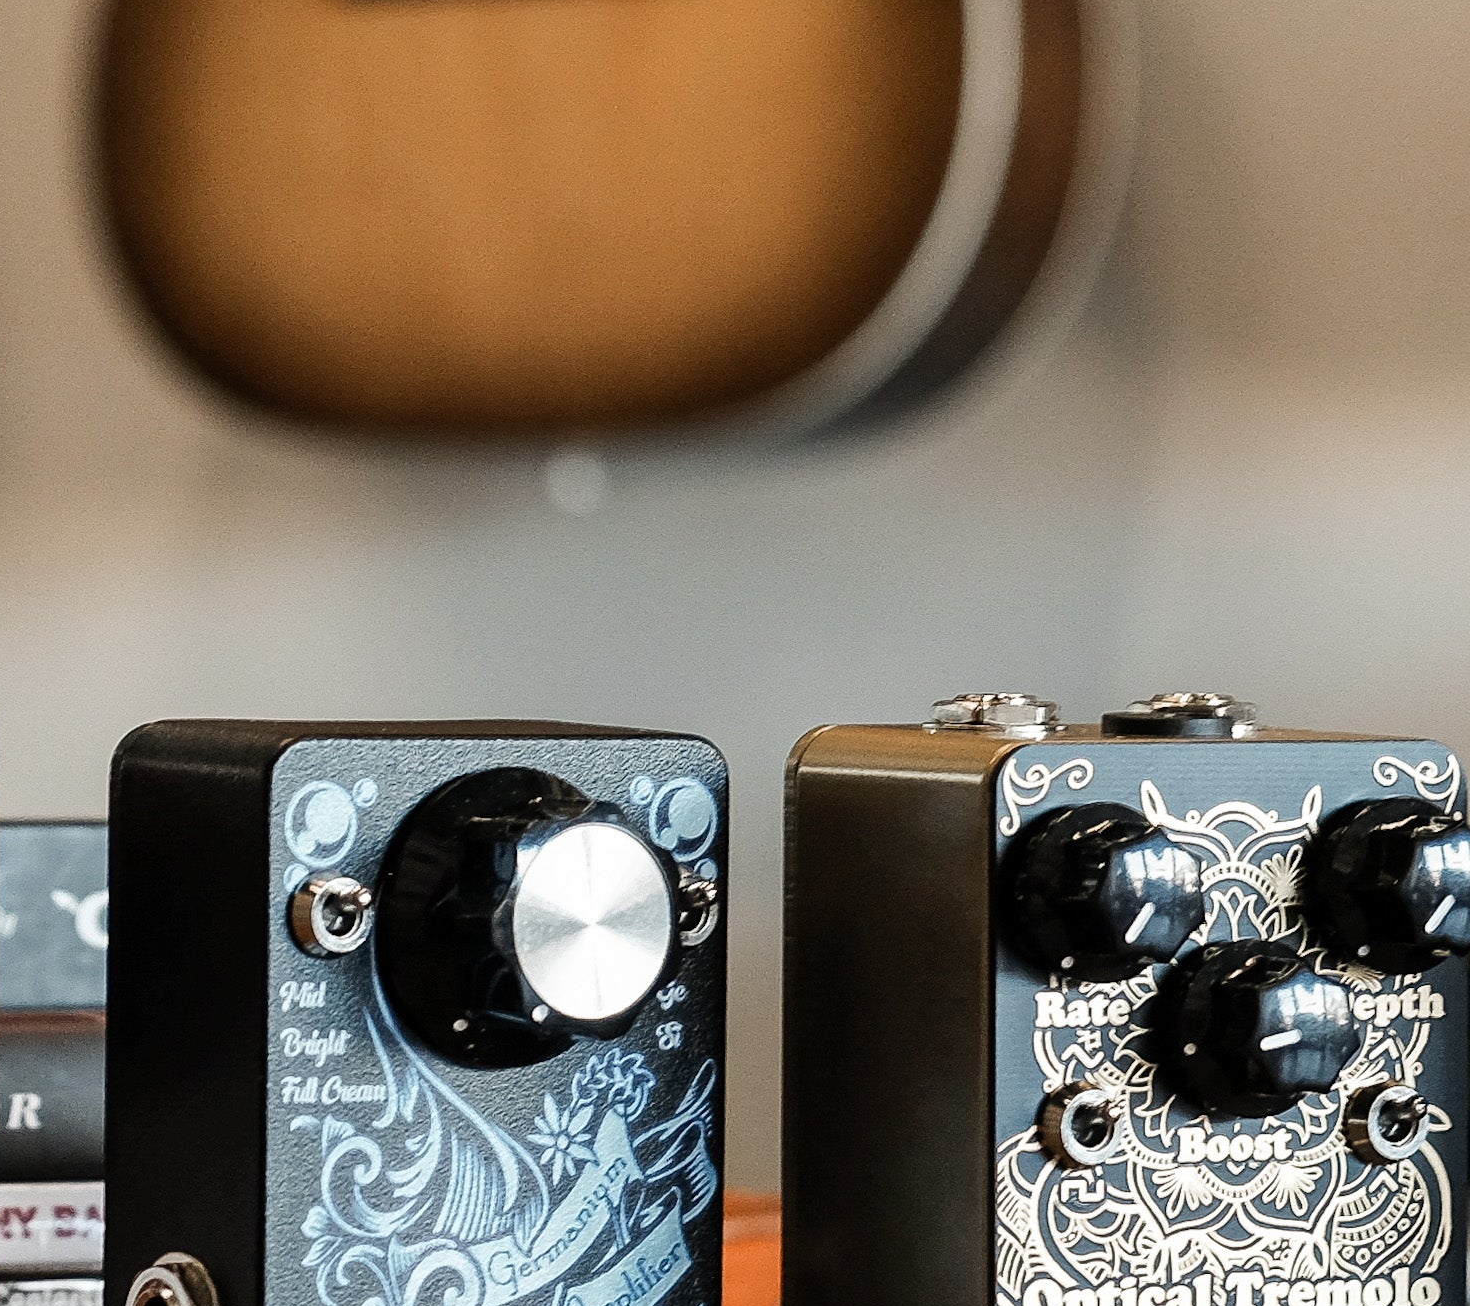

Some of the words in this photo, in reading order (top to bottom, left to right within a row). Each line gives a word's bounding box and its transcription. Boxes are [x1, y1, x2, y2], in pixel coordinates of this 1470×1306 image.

[1034, 991, 1130, 1029] Rate
[1348, 984, 1446, 1028] epth
[280, 1027, 352, 1068] Bright
[1176, 1125, 1293, 1163] Boost
[487, 1156, 629, 1297] Germanium
